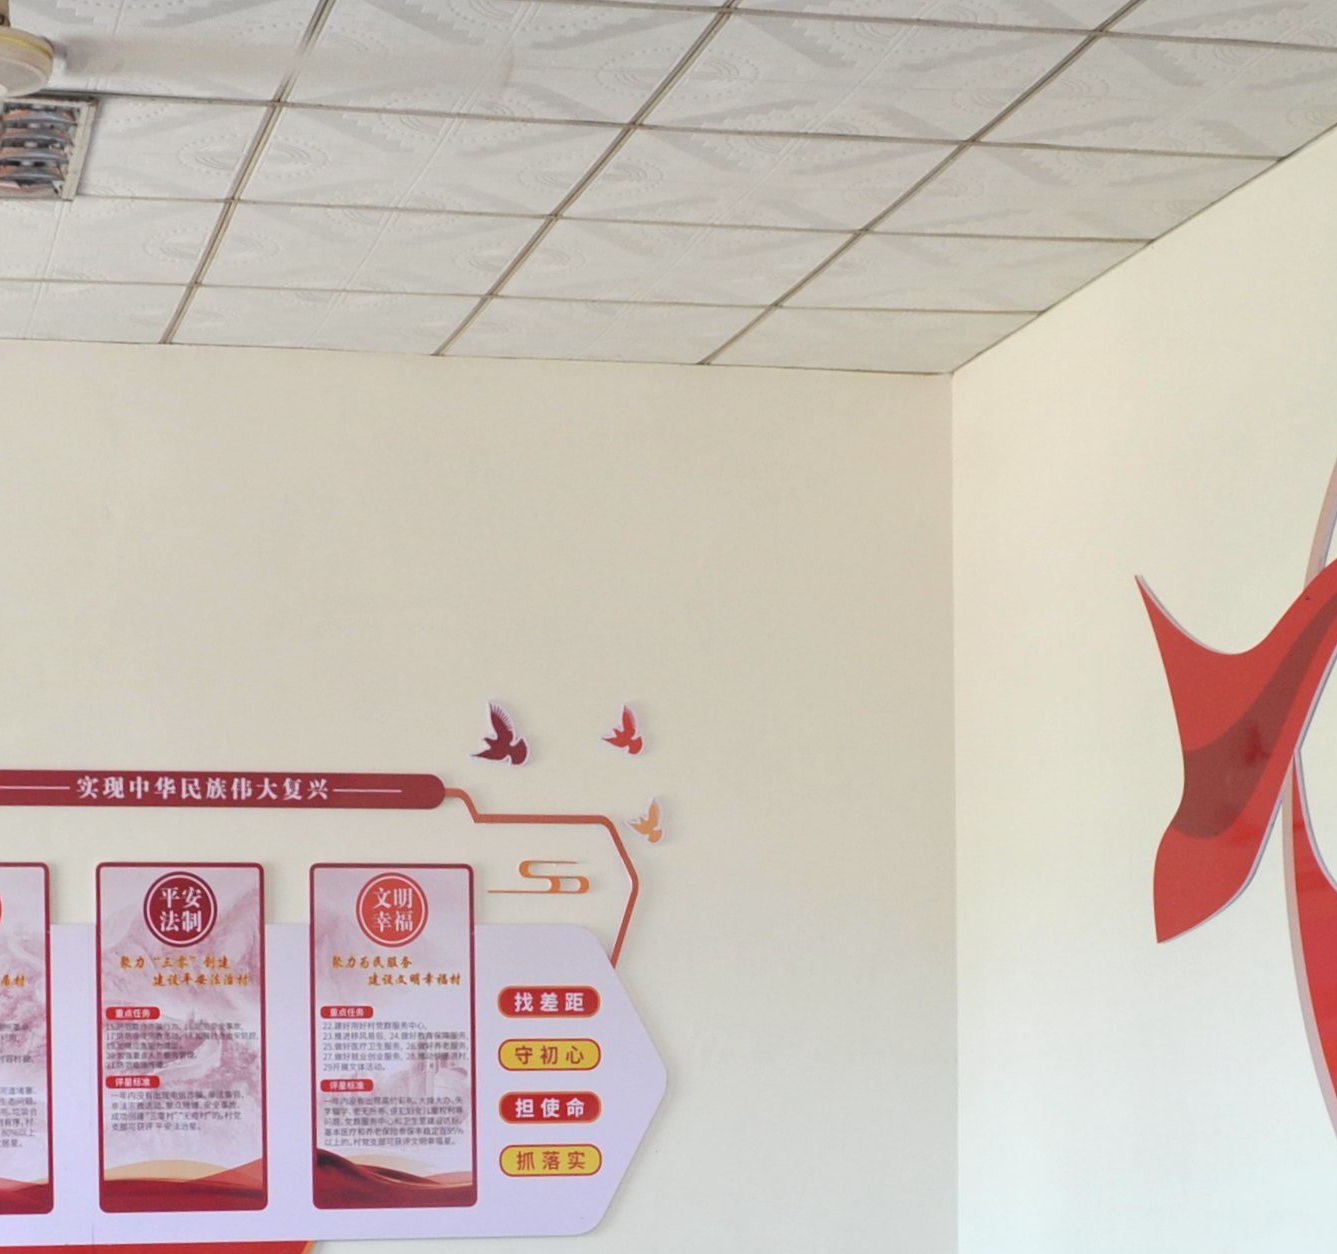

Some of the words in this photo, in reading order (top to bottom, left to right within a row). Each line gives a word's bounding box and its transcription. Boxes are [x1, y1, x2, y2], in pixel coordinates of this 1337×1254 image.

[76, 776, 329, 800] 实现中华民族伟大复兴
[160, 887, 202, 909] 平安
[373, 888, 413, 909] 文明
[160, 911, 202, 933] 法制
[373, 911, 413, 932] 幸福
[333, 956, 413, 969] 聚力为民服务
[153, 974, 249, 987] 建设平安法治村
[368, 973, 461, 987] 建设文明幸福村
[515, 992, 585, 1012] 找差距
[115, 1009, 151, 1019] 重点任务
[330, 1008, 364, 1018] 重点任务
[515, 1045, 584, 1065] 守初心
[115, 1077, 151, 1087] 评星标准
[330, 1081, 364, 1091] 评星标准
[515, 1098, 585, 1118] 担使命
[517, 1151, 585, 1171] 抓落实
